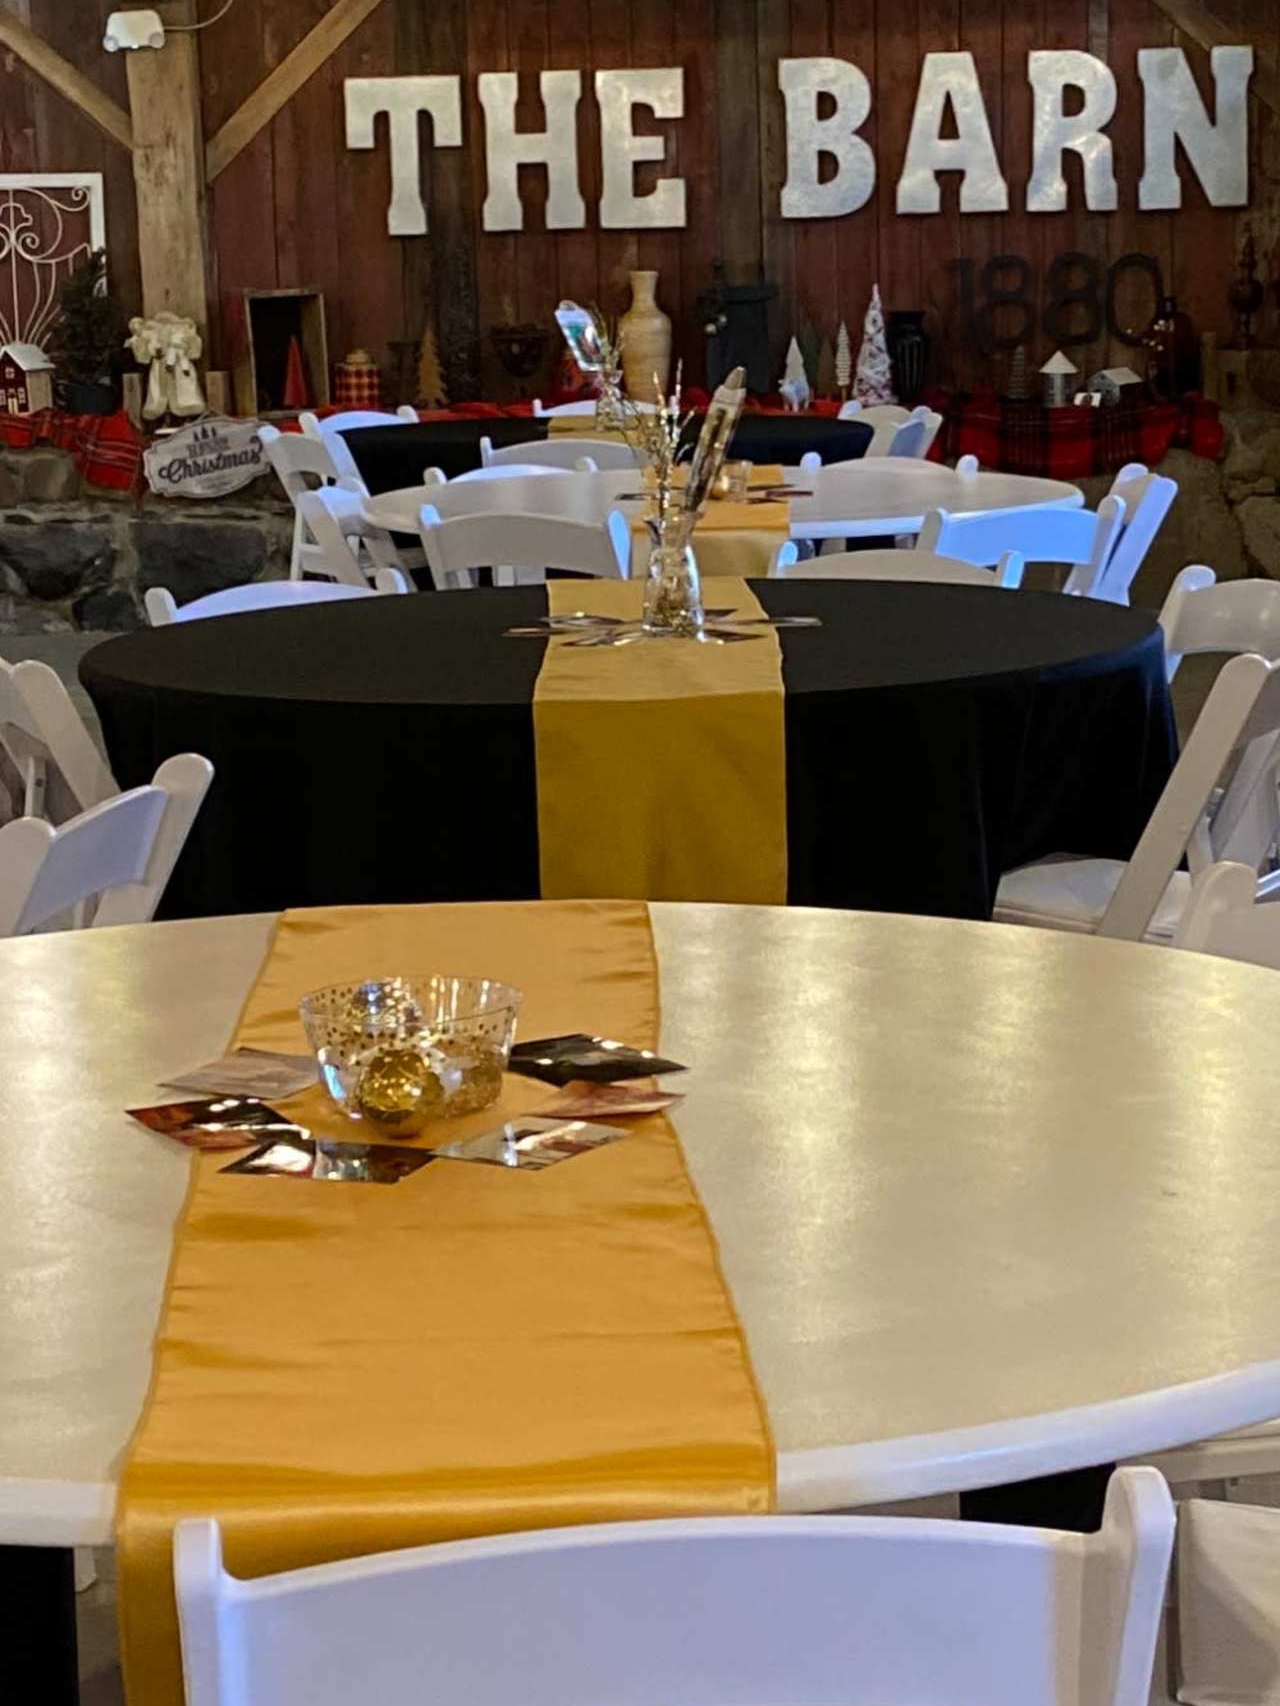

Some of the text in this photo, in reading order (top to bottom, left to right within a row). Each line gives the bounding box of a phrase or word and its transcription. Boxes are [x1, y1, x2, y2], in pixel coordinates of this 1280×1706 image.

[344, 44, 1254, 235] THE BARN
[948, 251, 1164, 349] 1880
[158, 435, 264, 483] Christmas
